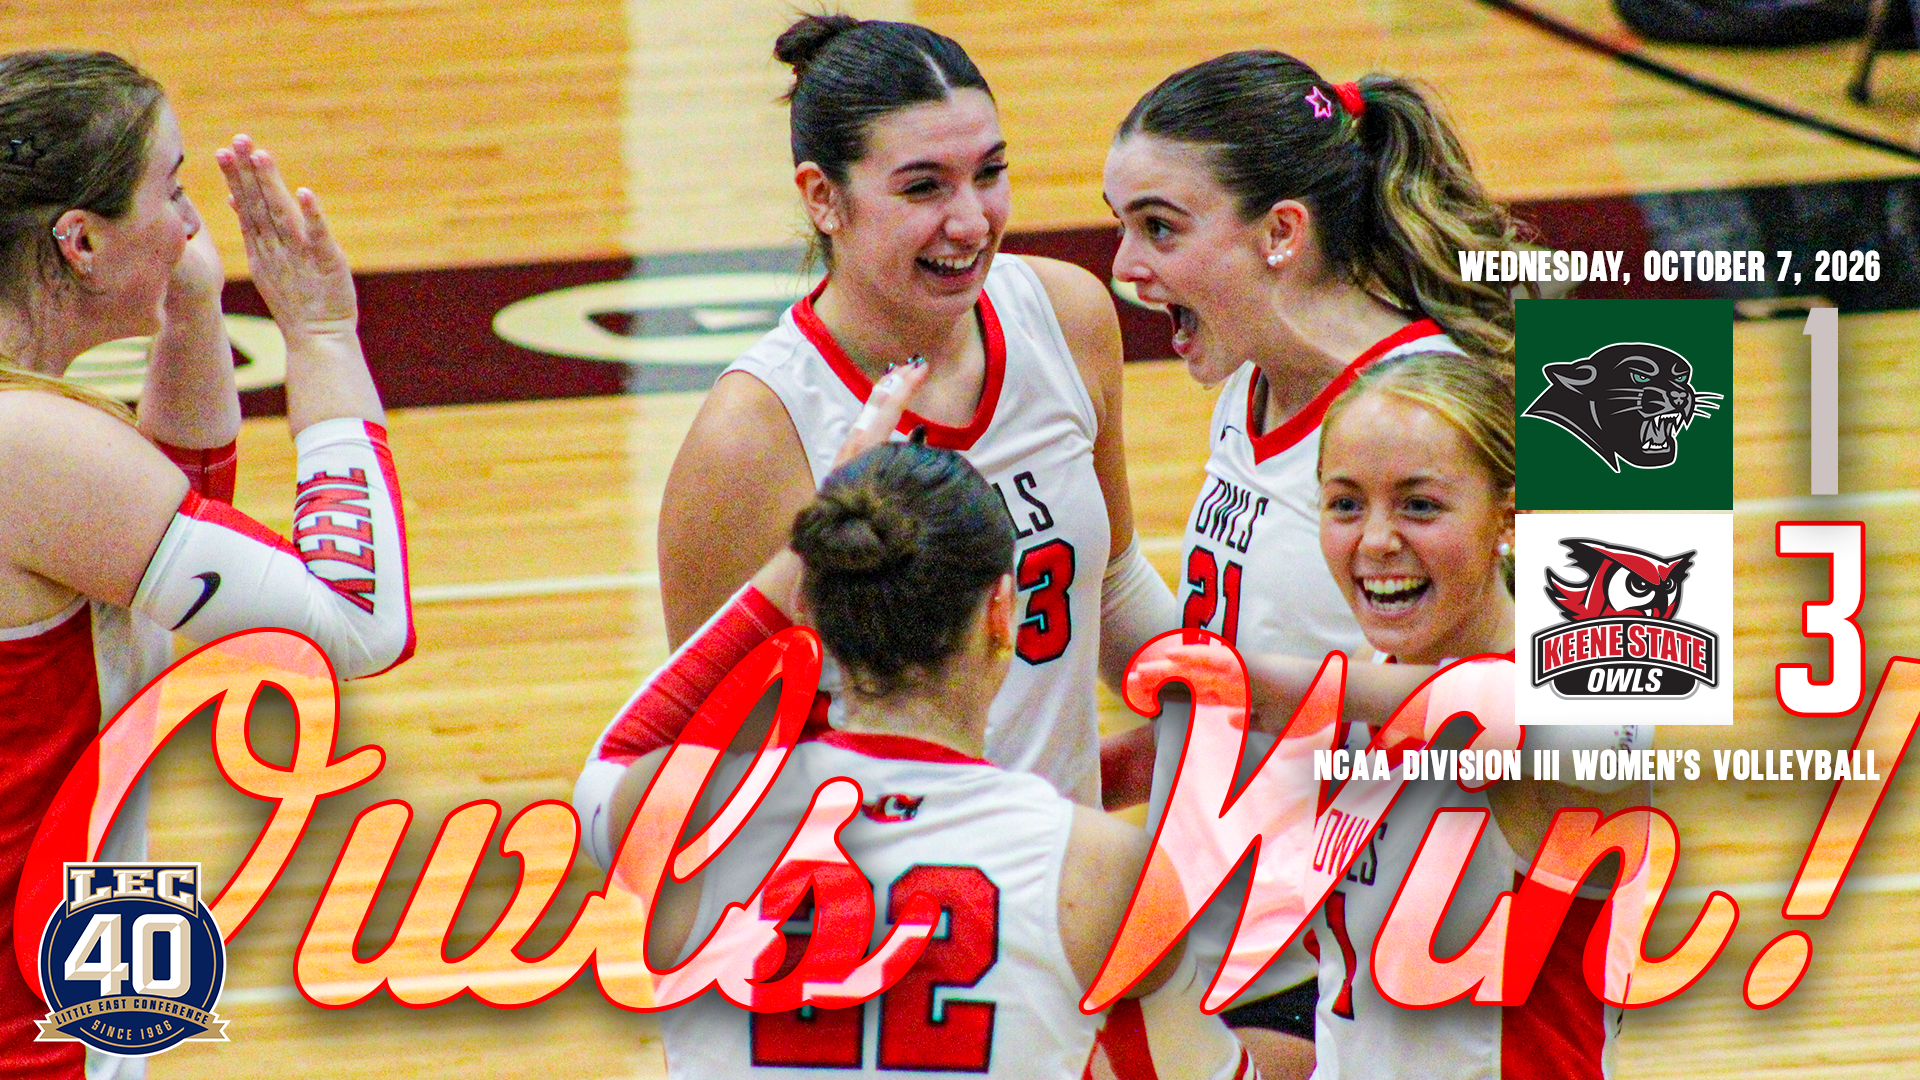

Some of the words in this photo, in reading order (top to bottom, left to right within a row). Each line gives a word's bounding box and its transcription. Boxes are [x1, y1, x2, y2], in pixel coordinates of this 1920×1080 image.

[293, 467, 376, 615] KEENE
[992, 471, 1054, 539] LS
[1195, 478, 1269, 554] OWLS
[1014, 537, 1076, 666] 3
[1182, 544, 1243, 646] 21
[1312, 807, 1388, 887] OWLS
[751, 860, 1000, 1075] 22
